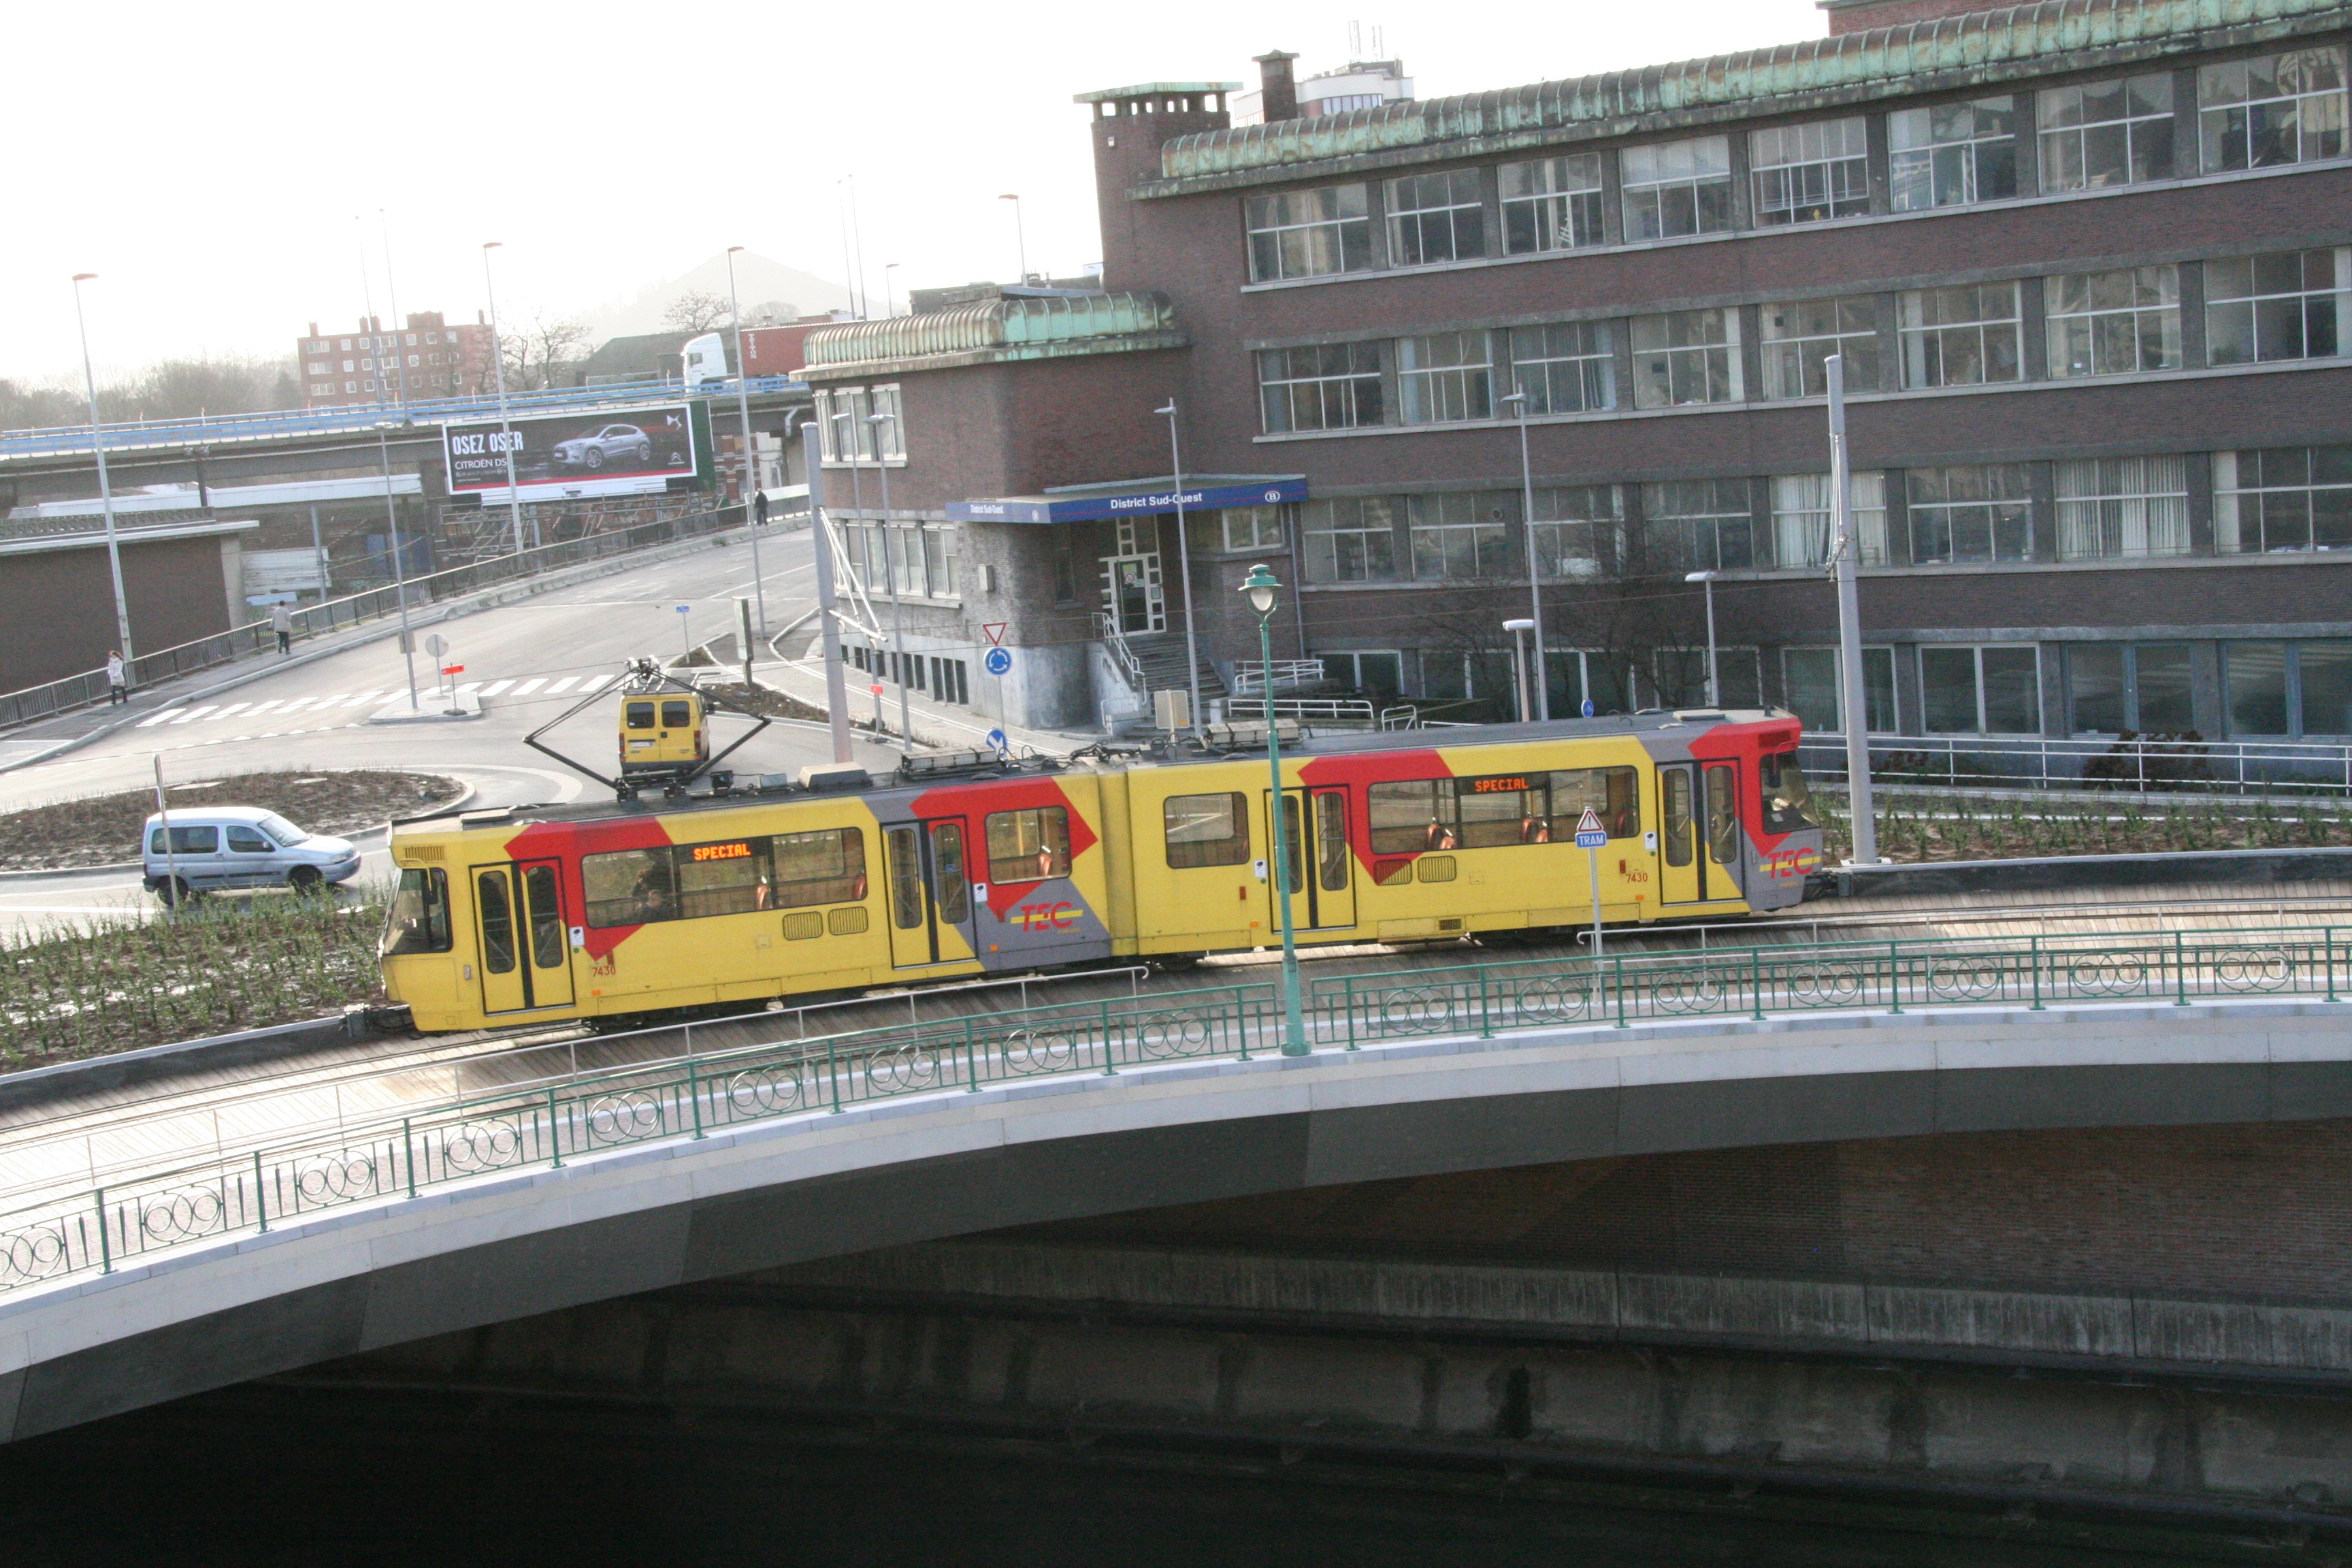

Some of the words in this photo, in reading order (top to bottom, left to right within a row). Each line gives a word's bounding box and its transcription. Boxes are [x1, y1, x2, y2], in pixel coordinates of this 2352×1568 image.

[452, 434, 485, 455] OSEZ
[489, 431, 523, 453] OSER
[455, 458, 493, 470] CITROËN
[1111, 497, 1146, 509] District
[1474, 777, 1530, 792] SPECIAL
[1579, 834, 1604, 847] TRAM
[693, 843, 751, 861] SPECIAL
[1769, 847, 1814, 880] TEC
[1625, 872, 1648, 883] 7430
[1021, 901, 1074, 932] TEC
[592, 965, 616, 977] 7430
